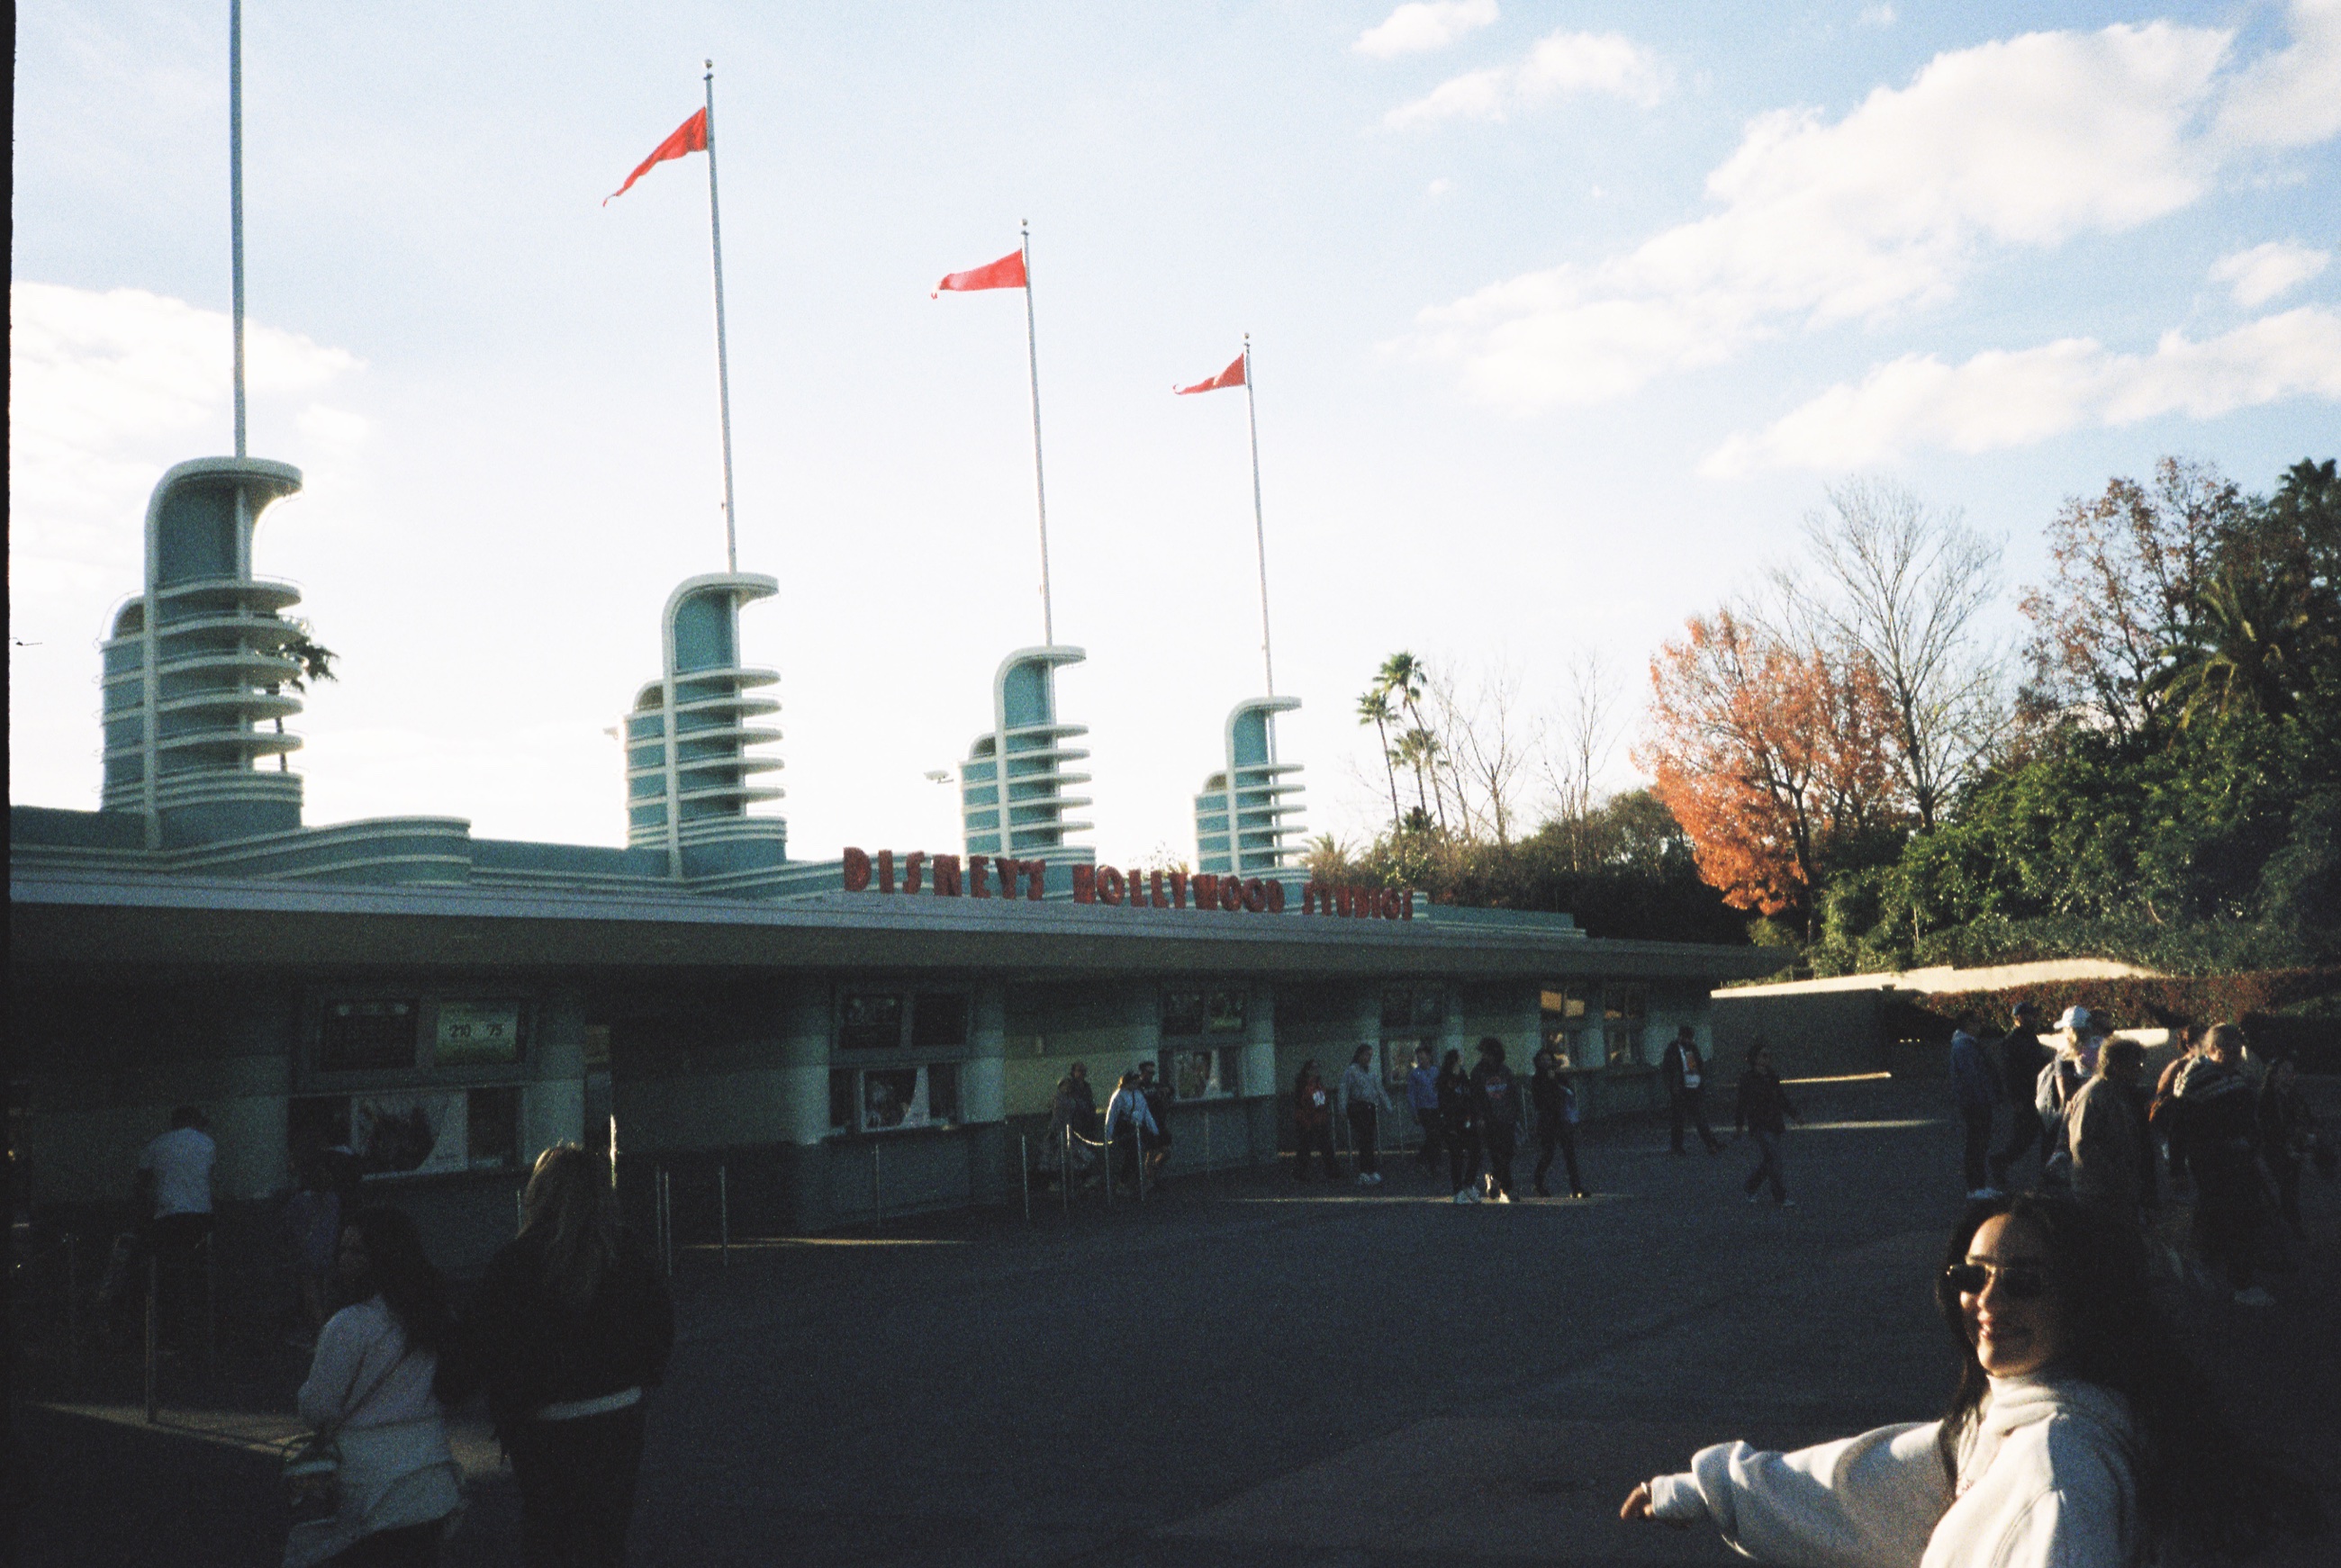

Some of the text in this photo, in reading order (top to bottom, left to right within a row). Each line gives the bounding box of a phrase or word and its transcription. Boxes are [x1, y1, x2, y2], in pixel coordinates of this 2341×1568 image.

[844, 847, 1413, 921] DISNEY'S HOLLYWOOD STUDIOS
